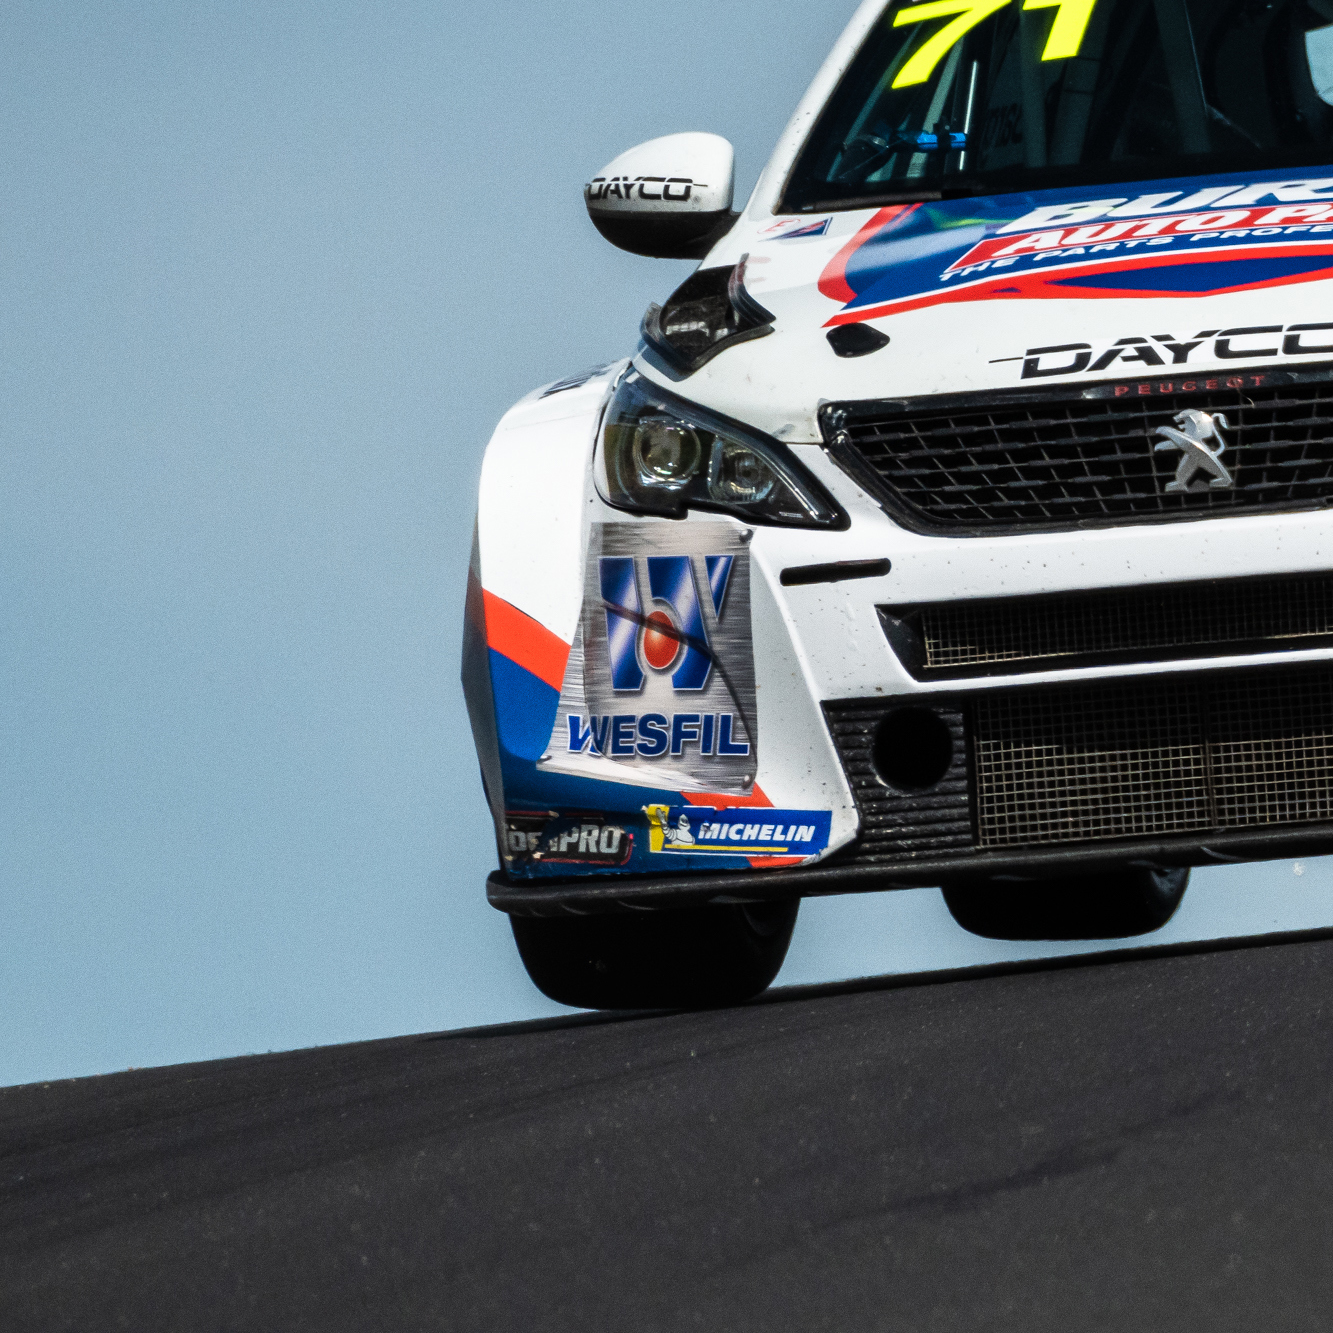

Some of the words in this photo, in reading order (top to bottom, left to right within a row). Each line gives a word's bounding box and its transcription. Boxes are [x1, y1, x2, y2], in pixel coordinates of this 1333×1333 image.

[586, 175, 694, 202] DAYCO
[998, 210, 1232, 256] AUTO
[939, 255, 1020, 282] THE
[1032, 236, 1175, 262] PARTS
[1113, 374, 1267, 398] PEUGEOT
[565, 712, 751, 758] WESFIL
[697, 822, 816, 843] MICHELIN
